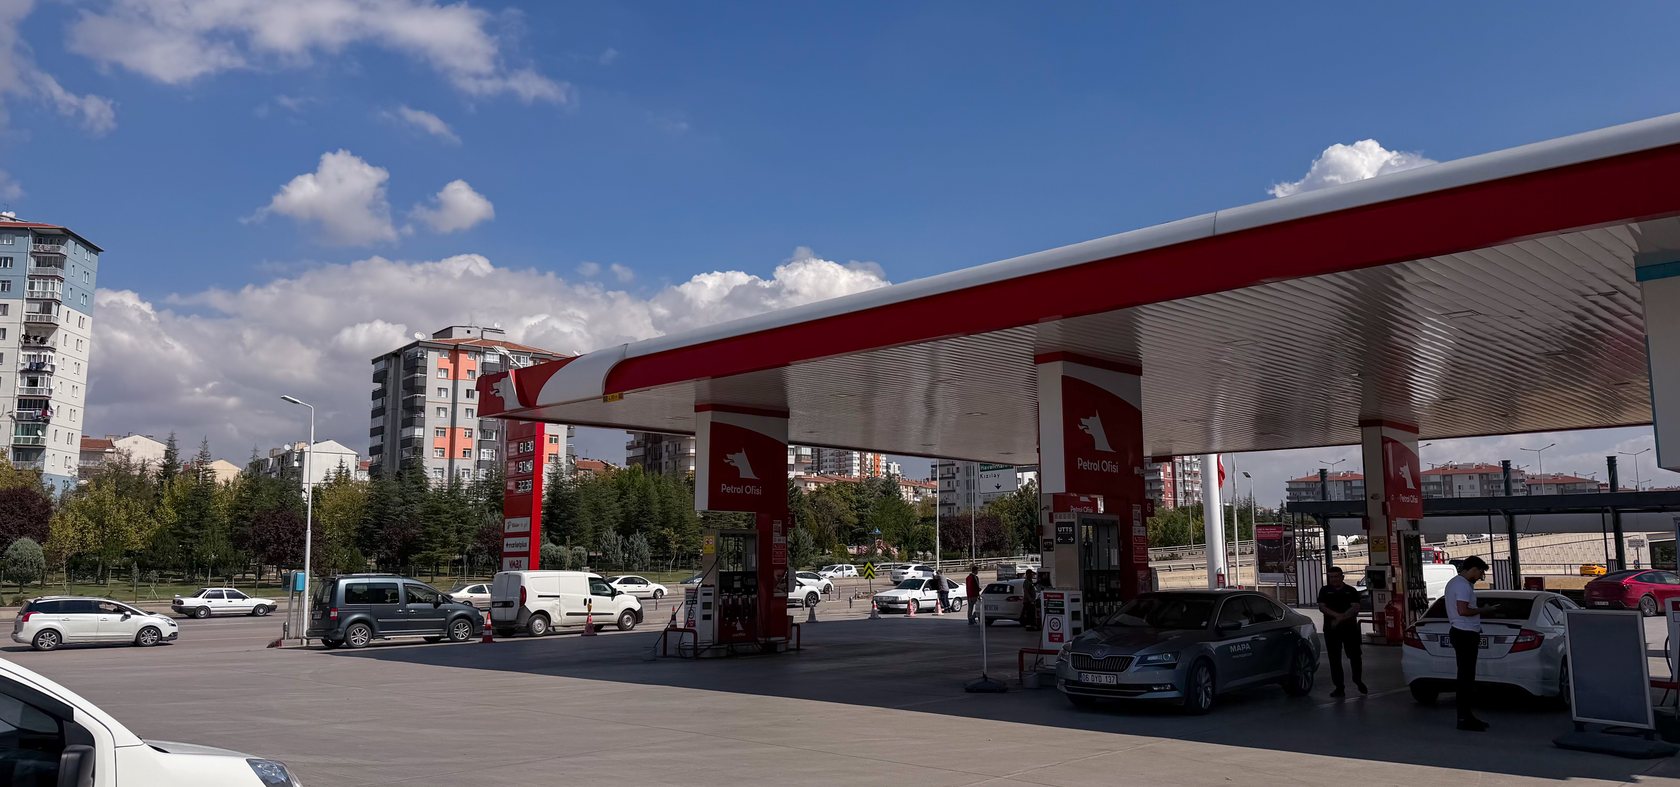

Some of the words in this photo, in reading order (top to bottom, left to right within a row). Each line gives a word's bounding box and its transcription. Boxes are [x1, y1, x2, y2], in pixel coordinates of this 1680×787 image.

[1077, 457, 1100, 471] Petrol
[1101, 460, 1119, 473] Ofisi
[721, 483, 744, 494] Petrol
[745, 485, 762, 496] Ofisi
[1230, 643, 1252, 653] MAPA
